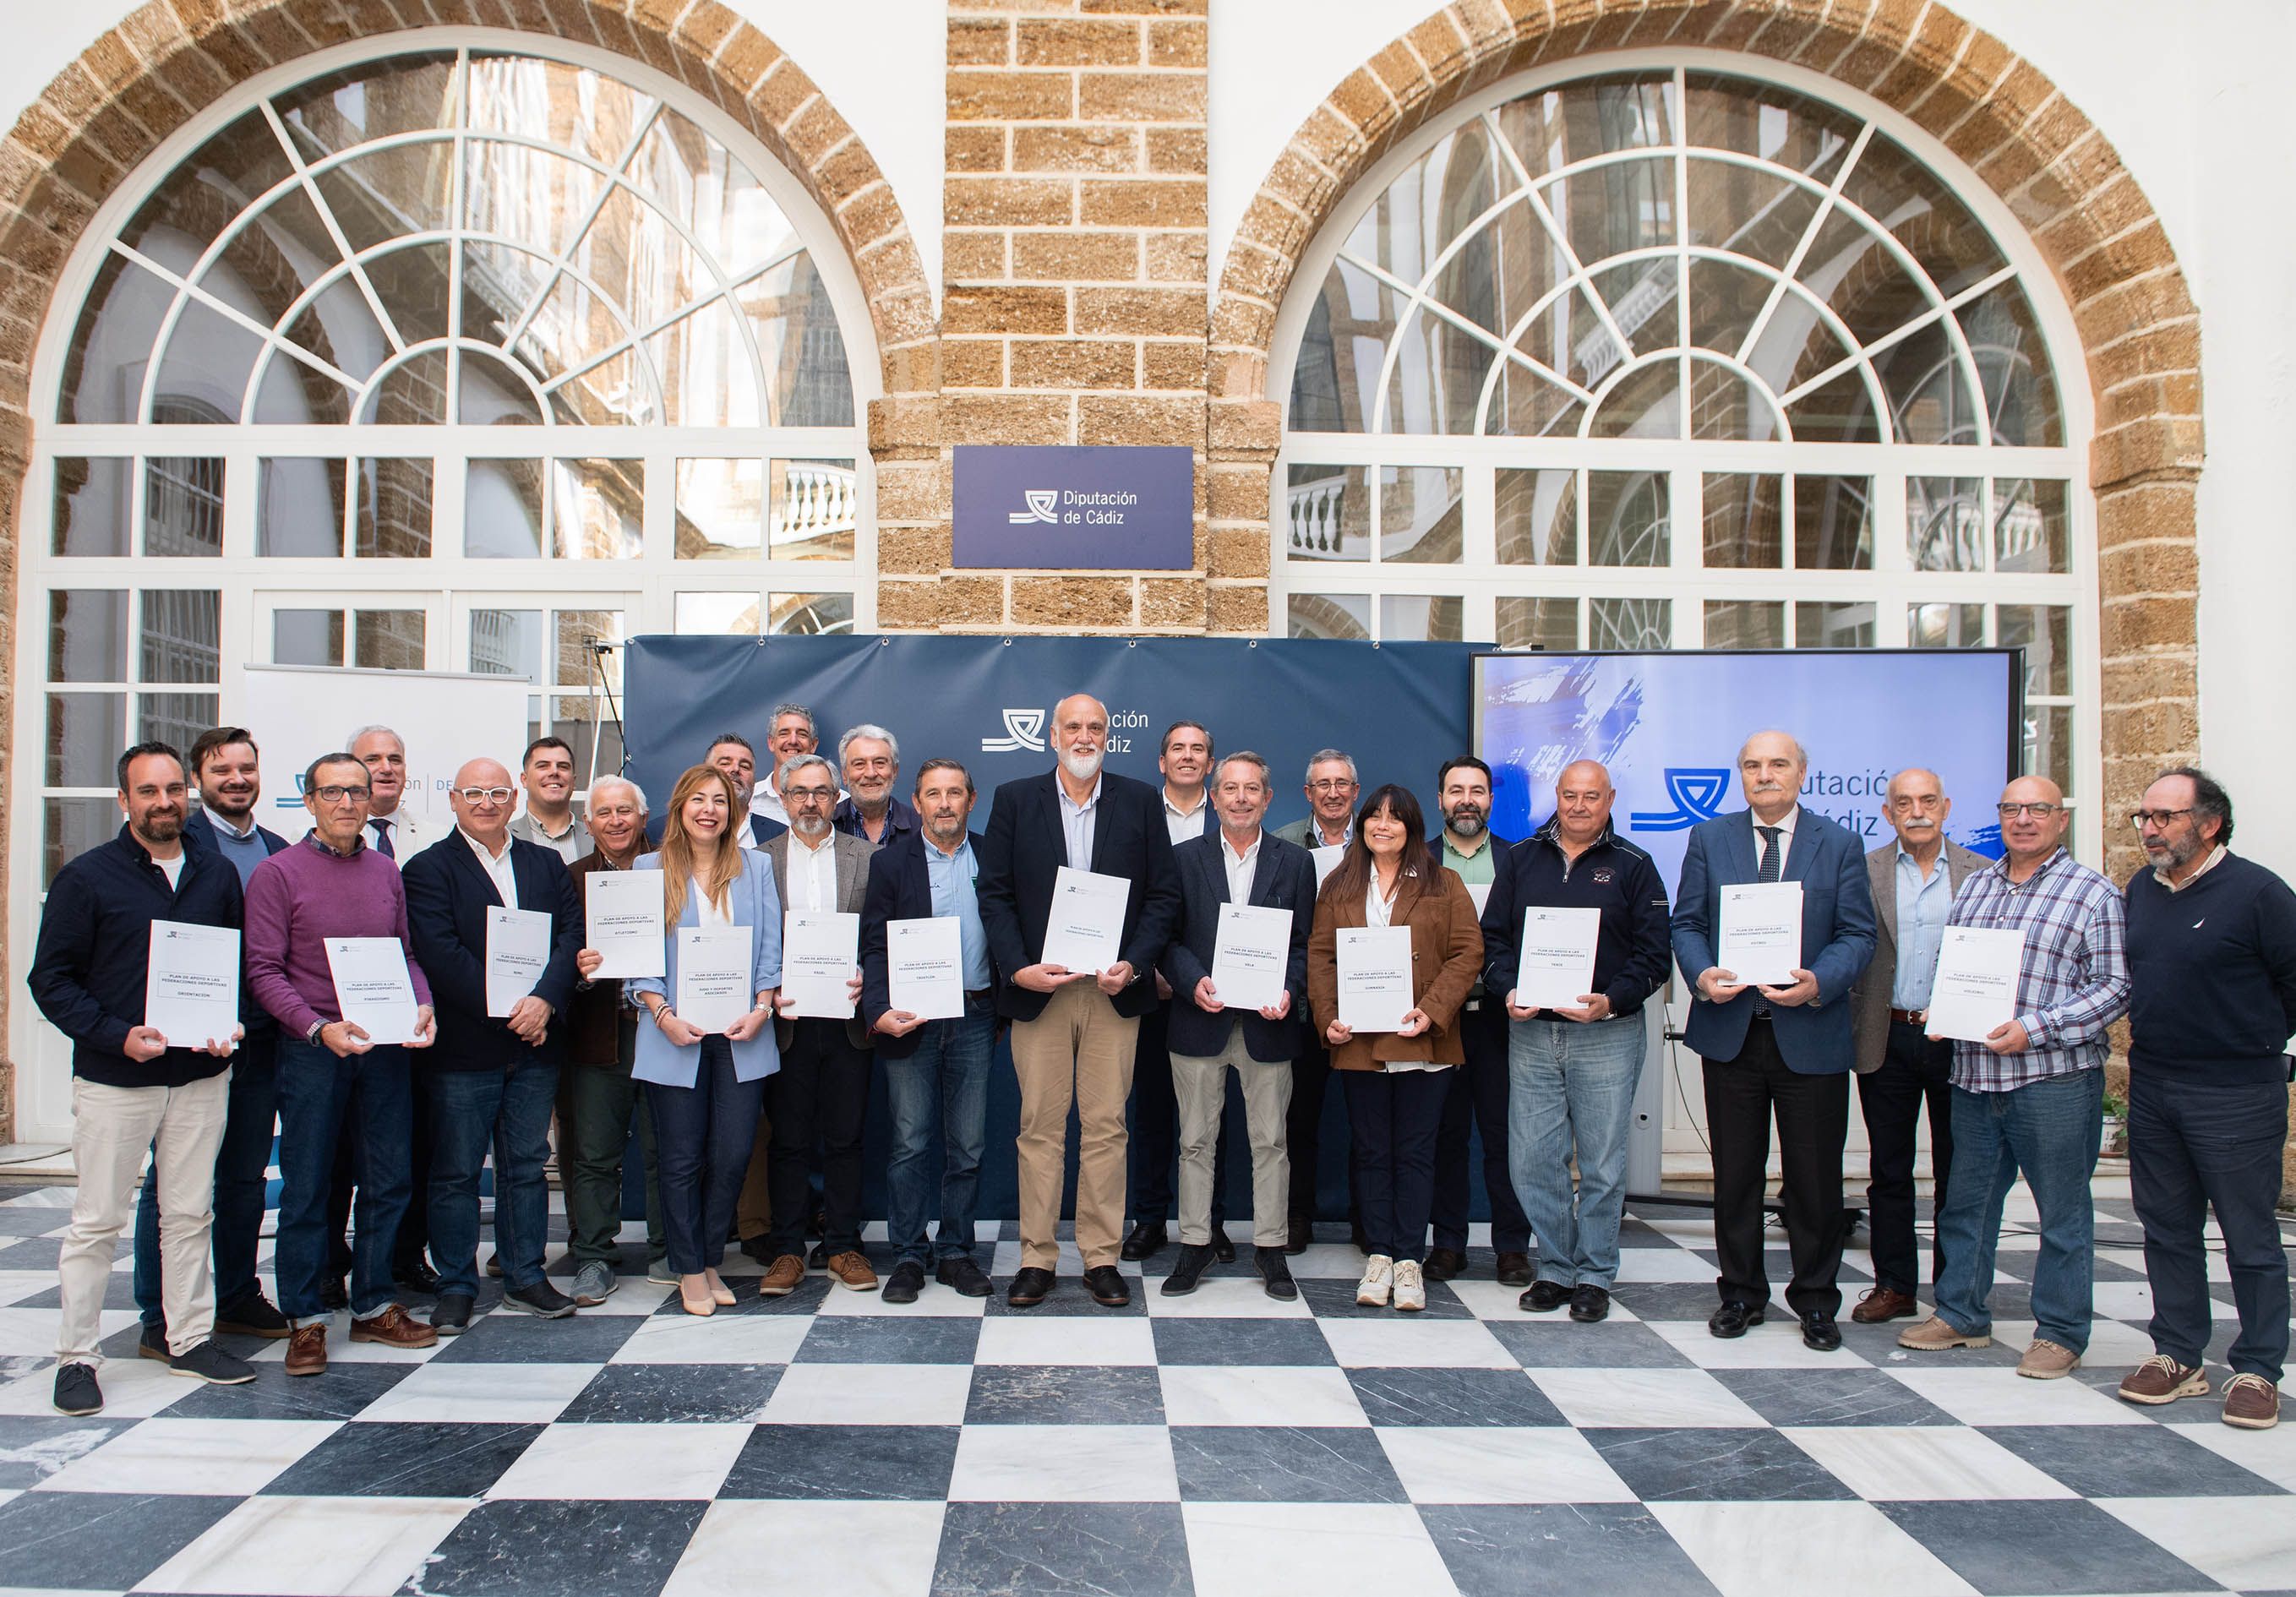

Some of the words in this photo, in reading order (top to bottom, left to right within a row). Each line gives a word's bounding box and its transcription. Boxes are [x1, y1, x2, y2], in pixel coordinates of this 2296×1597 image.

[1064, 490, 1137, 506] Diputación
[1064, 511, 1081, 524] de
[1086, 510, 1124, 525] Cádiz
